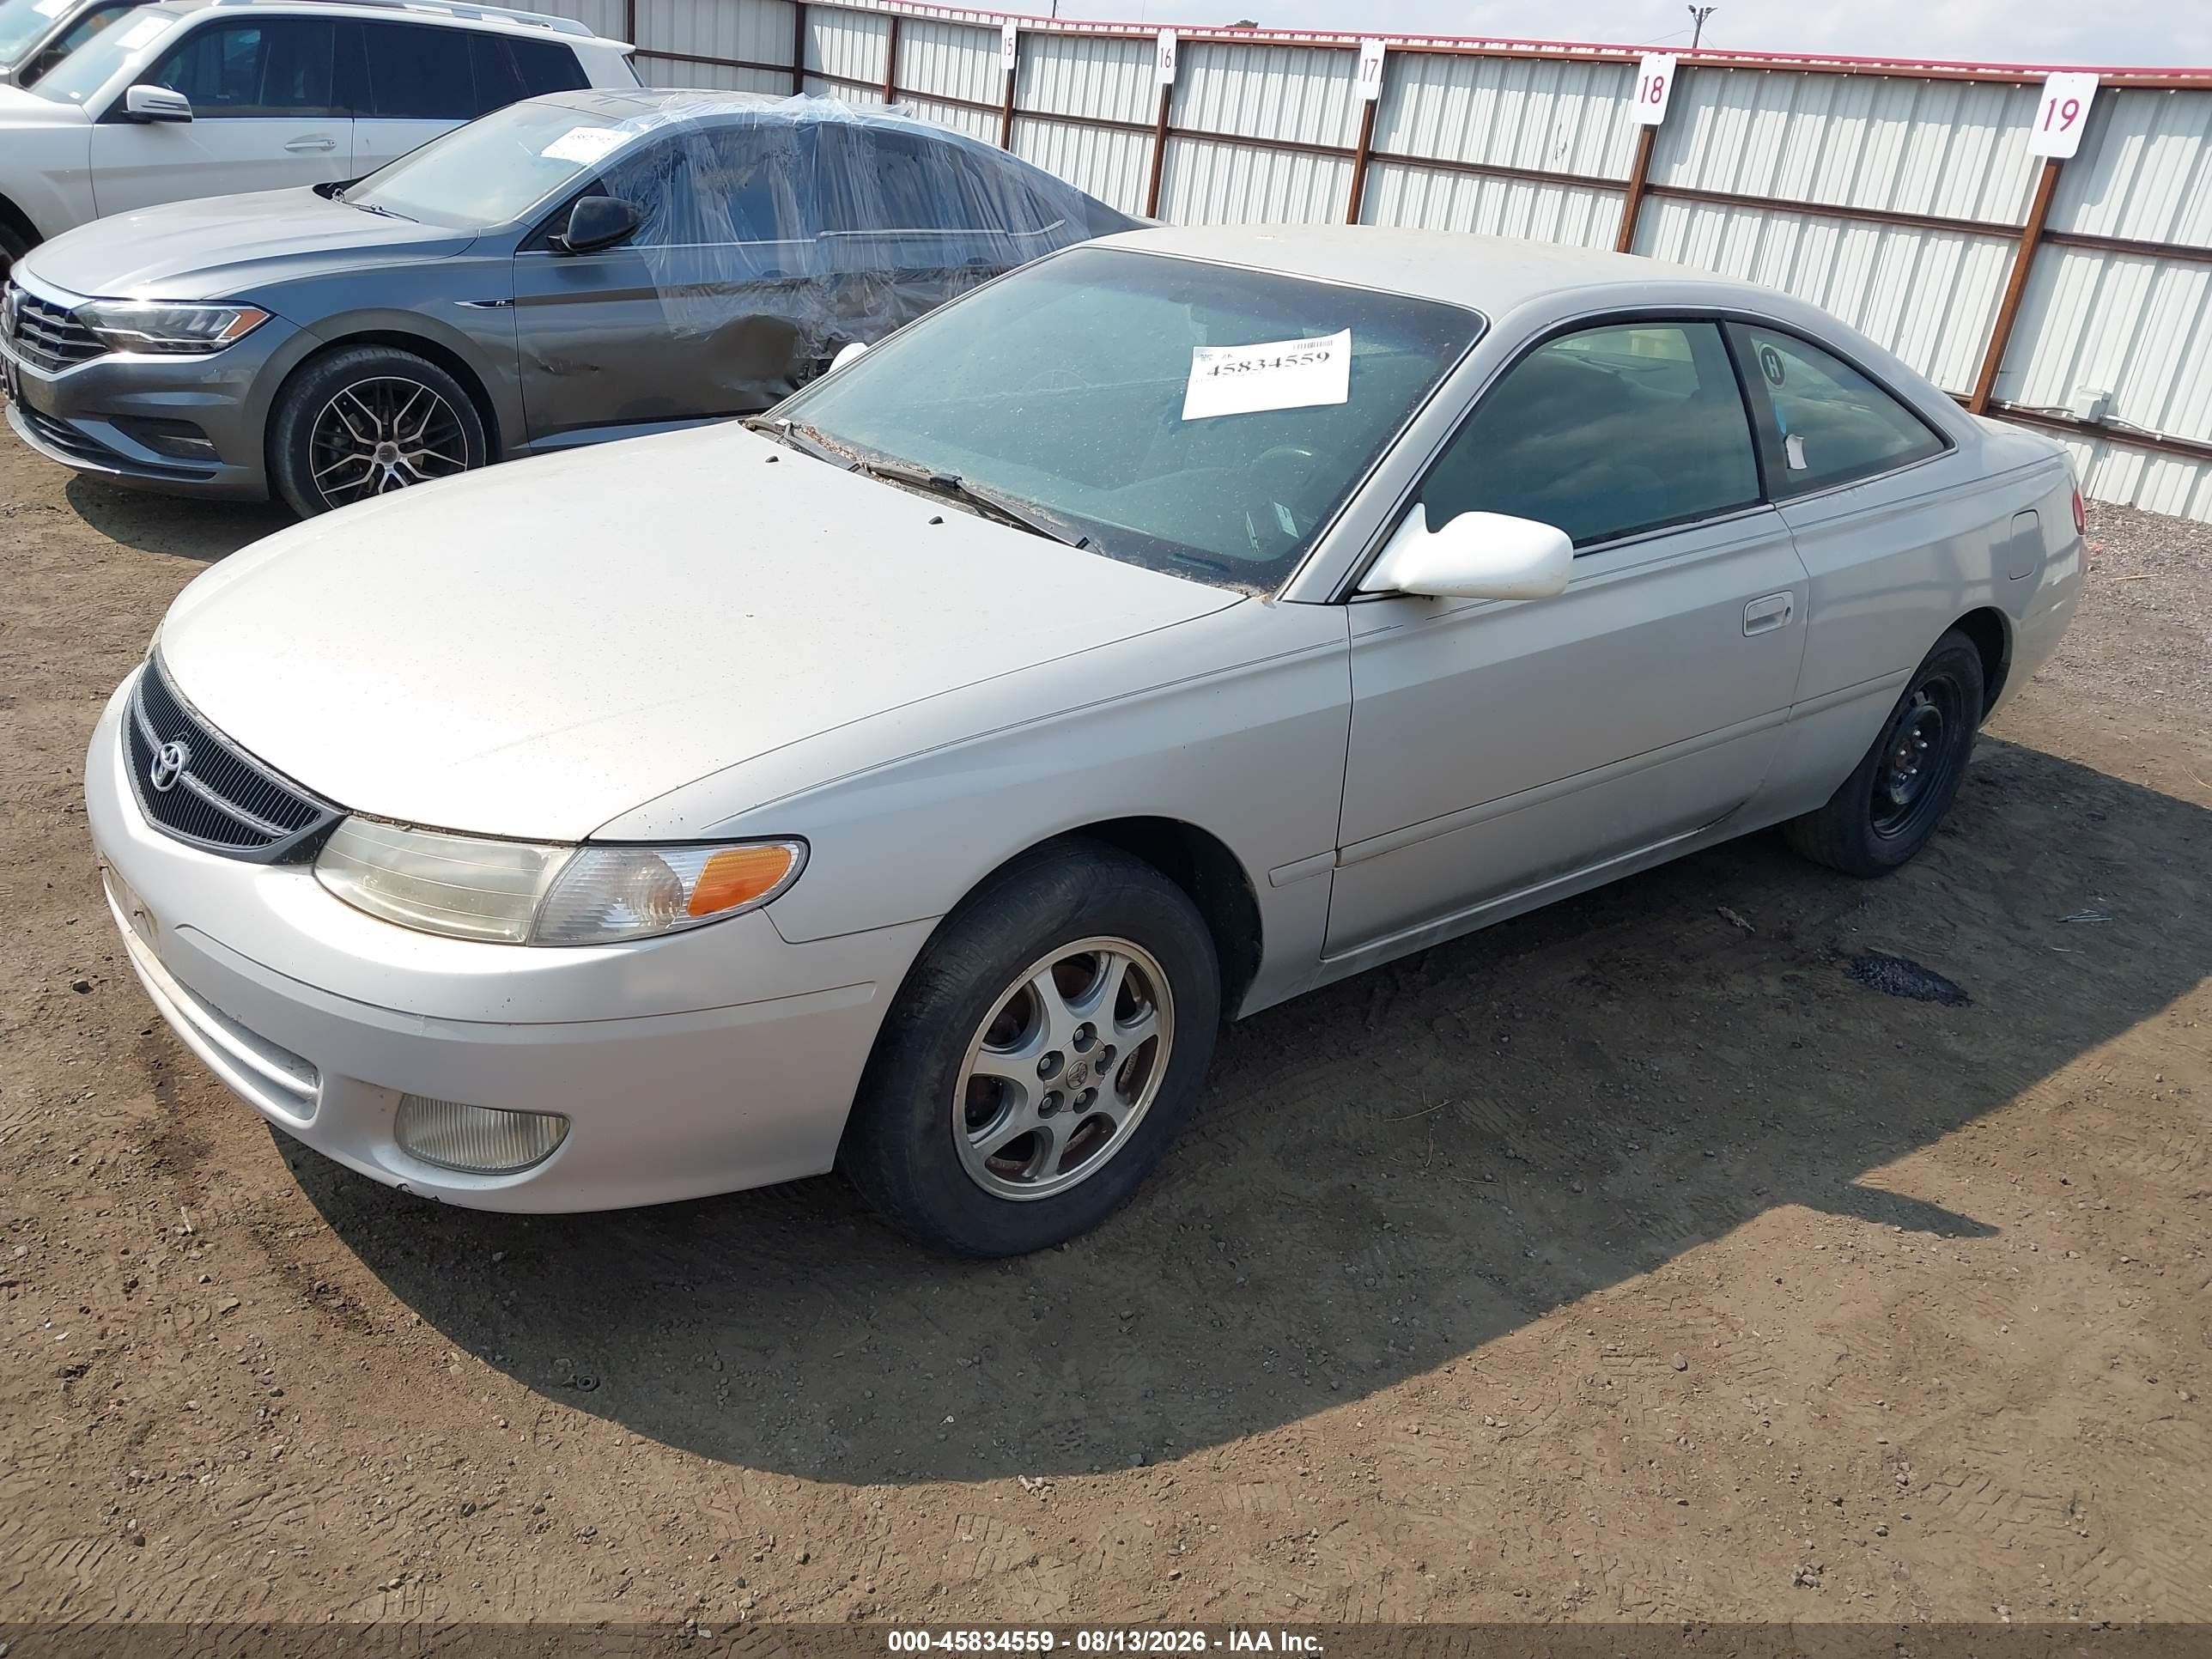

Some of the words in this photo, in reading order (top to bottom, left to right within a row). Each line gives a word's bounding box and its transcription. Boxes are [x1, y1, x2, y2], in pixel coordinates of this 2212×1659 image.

[1004, 38, 1012, 56] 15
[1160, 48, 1171, 68] 16
[1363, 58, 1378, 82] 17
[1641, 75, 1664, 104] 18
[2043, 97, 2080, 132] 19
[1206, 351, 1330, 376] 45834559
